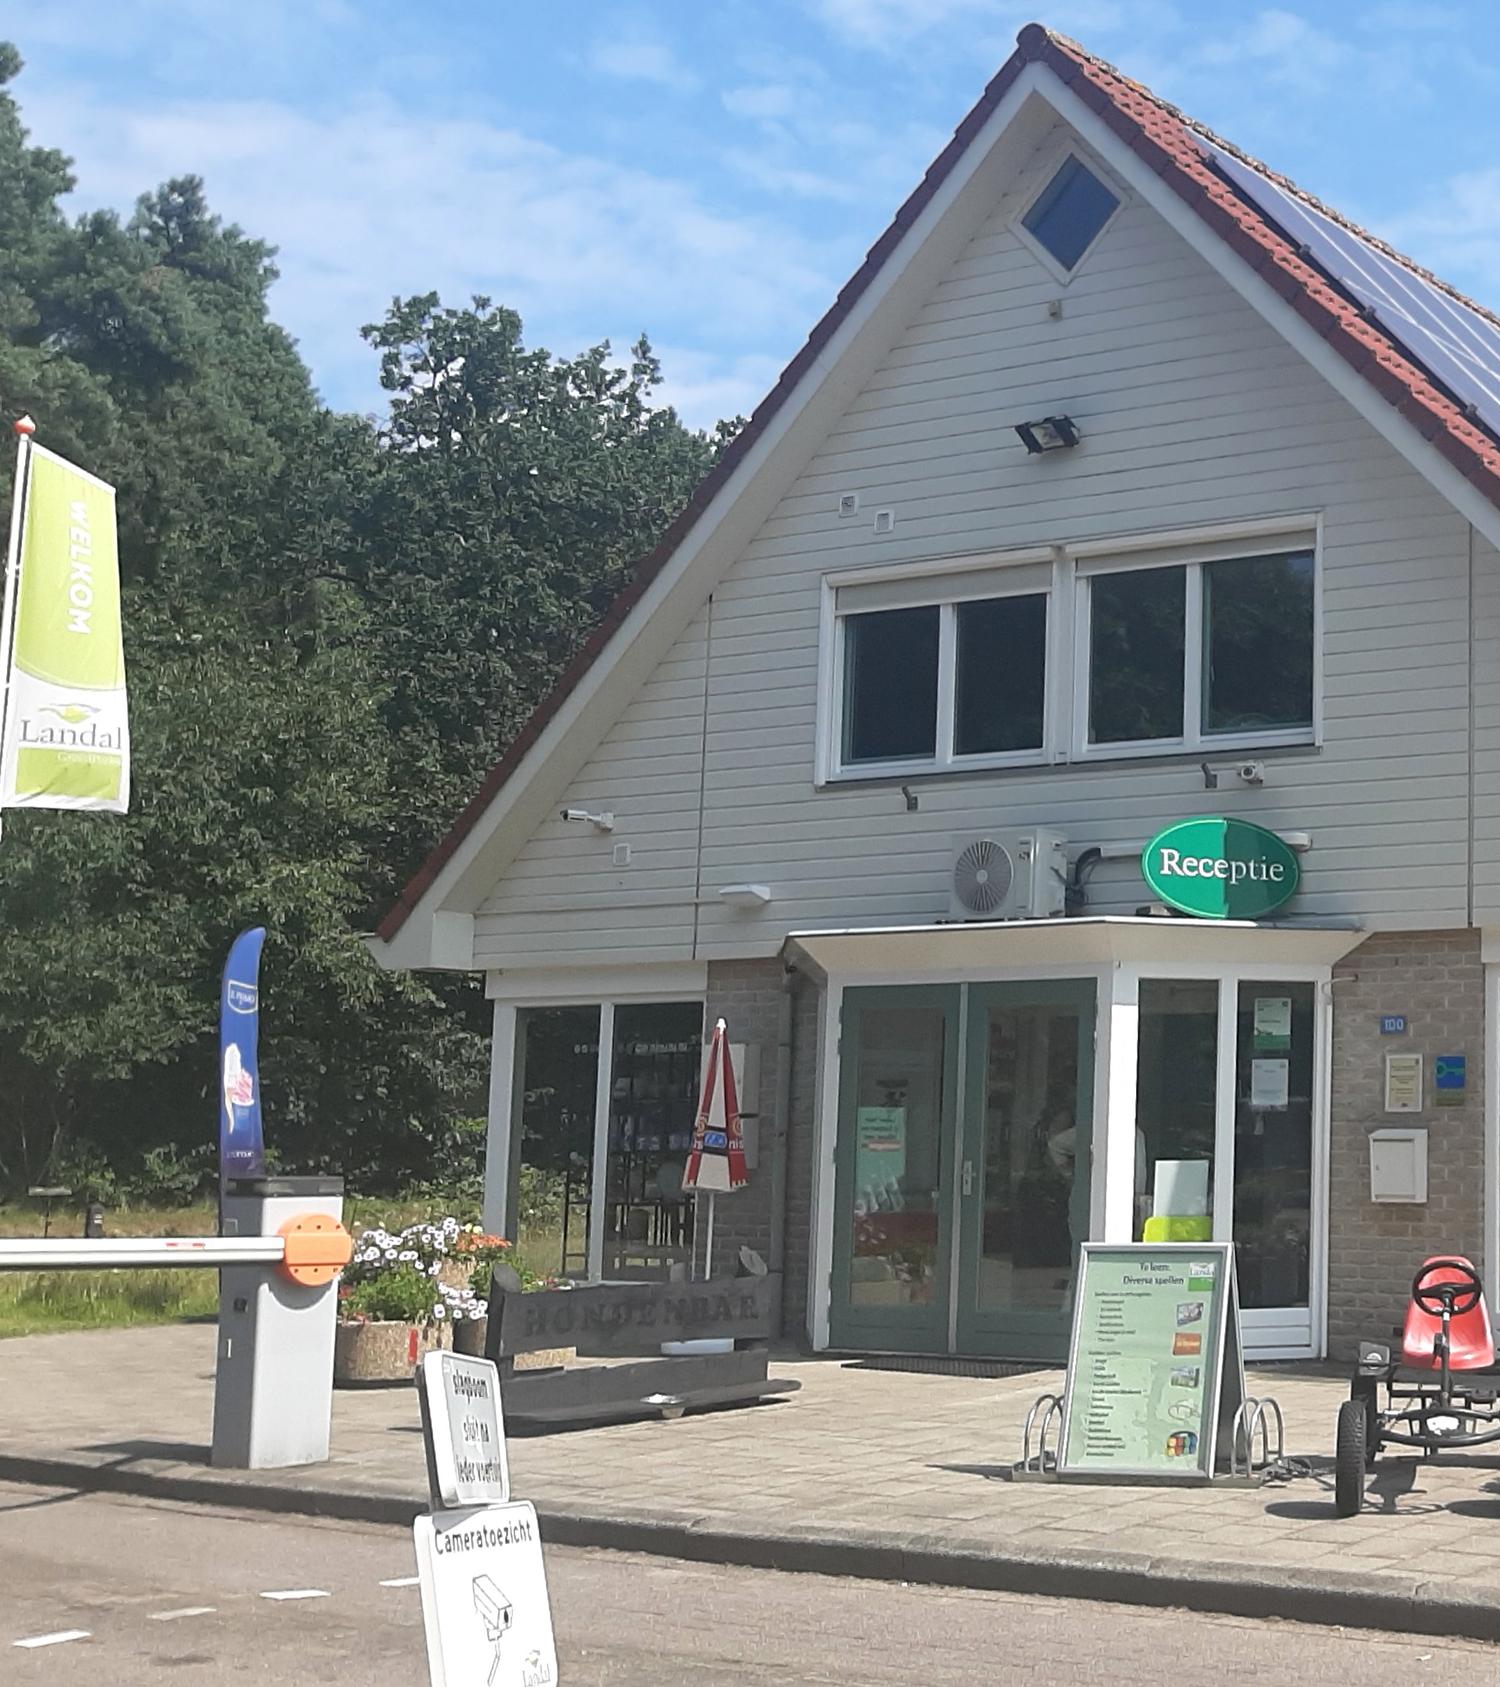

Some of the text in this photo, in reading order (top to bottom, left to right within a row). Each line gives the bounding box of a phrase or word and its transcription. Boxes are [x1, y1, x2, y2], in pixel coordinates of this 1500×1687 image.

[67, 500, 95, 635] WELKOM
[19, 719, 122, 750] Landal
[1159, 848, 1284, 885] Receptie
[435, 1519, 532, 1555] Cameratoezicht
